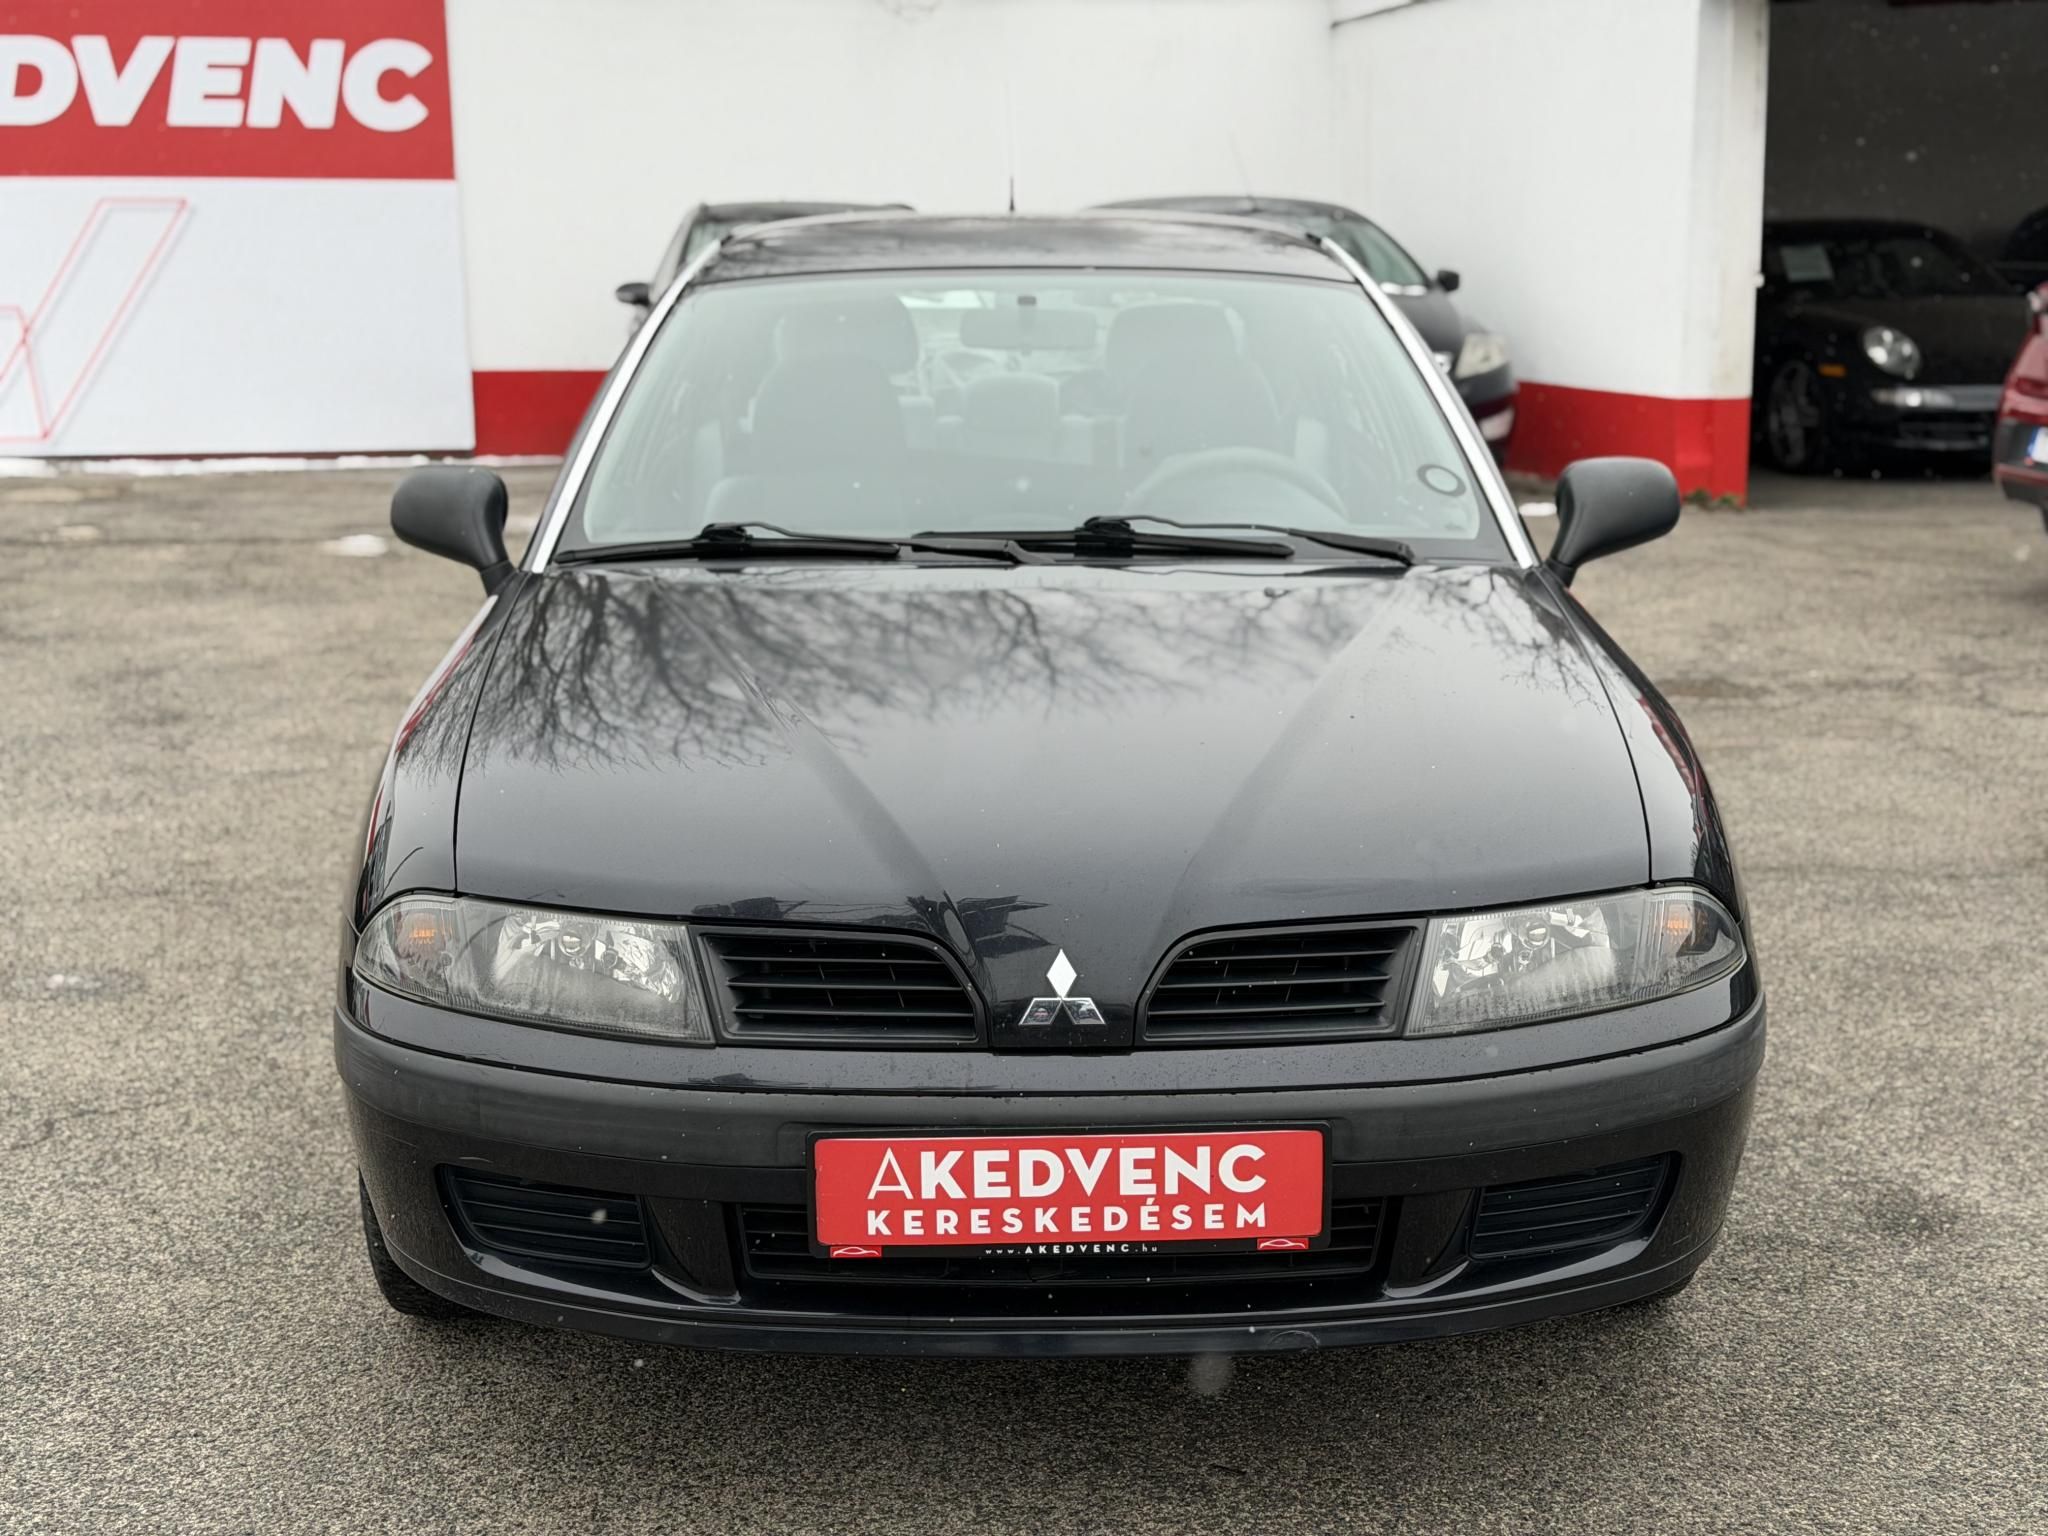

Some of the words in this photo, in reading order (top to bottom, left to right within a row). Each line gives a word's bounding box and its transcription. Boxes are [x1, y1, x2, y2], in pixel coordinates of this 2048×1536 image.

[0, 35, 432, 131] DVENC
[867, 1198, 1266, 1236] KERESKEDÉSEM
[985, 1243, 1158, 1255] www.AKEDVENC.hu
